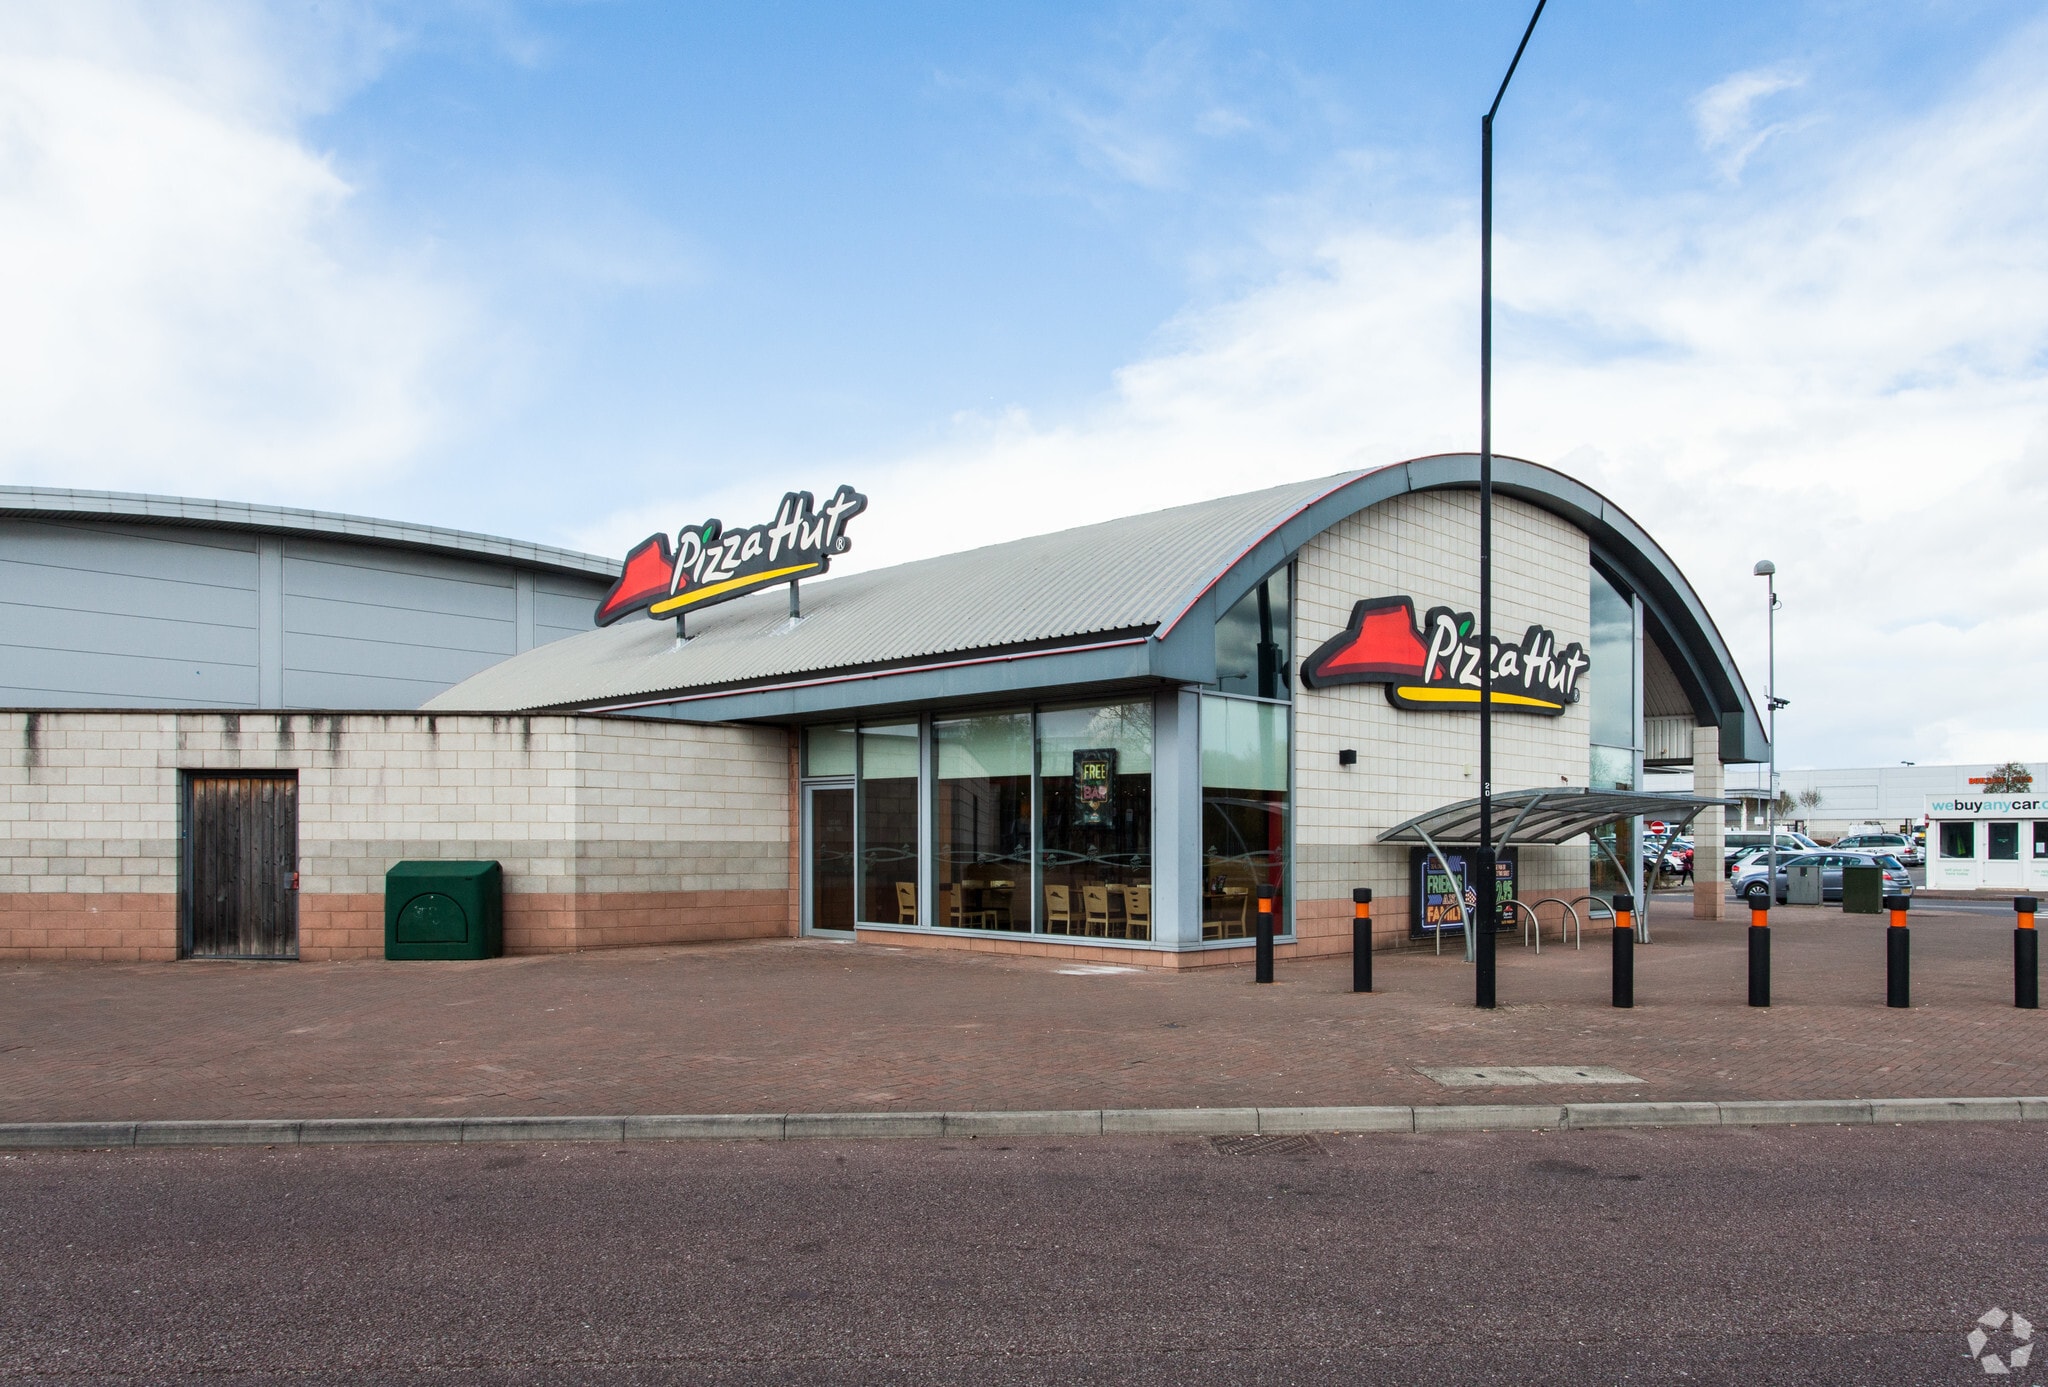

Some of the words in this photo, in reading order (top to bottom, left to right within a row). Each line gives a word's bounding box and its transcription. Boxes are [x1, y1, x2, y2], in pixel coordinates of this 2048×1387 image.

[670, 525, 762, 596] Pizza
[767, 492, 857, 562] Hut
[1424, 614, 1520, 687] Pizza
[1523, 632, 1588, 694] Hut
[1083, 764, 1106, 780] FREE
[1485, 782, 1490, 797] 20
[1427, 905, 1462, 923] FAMILY
